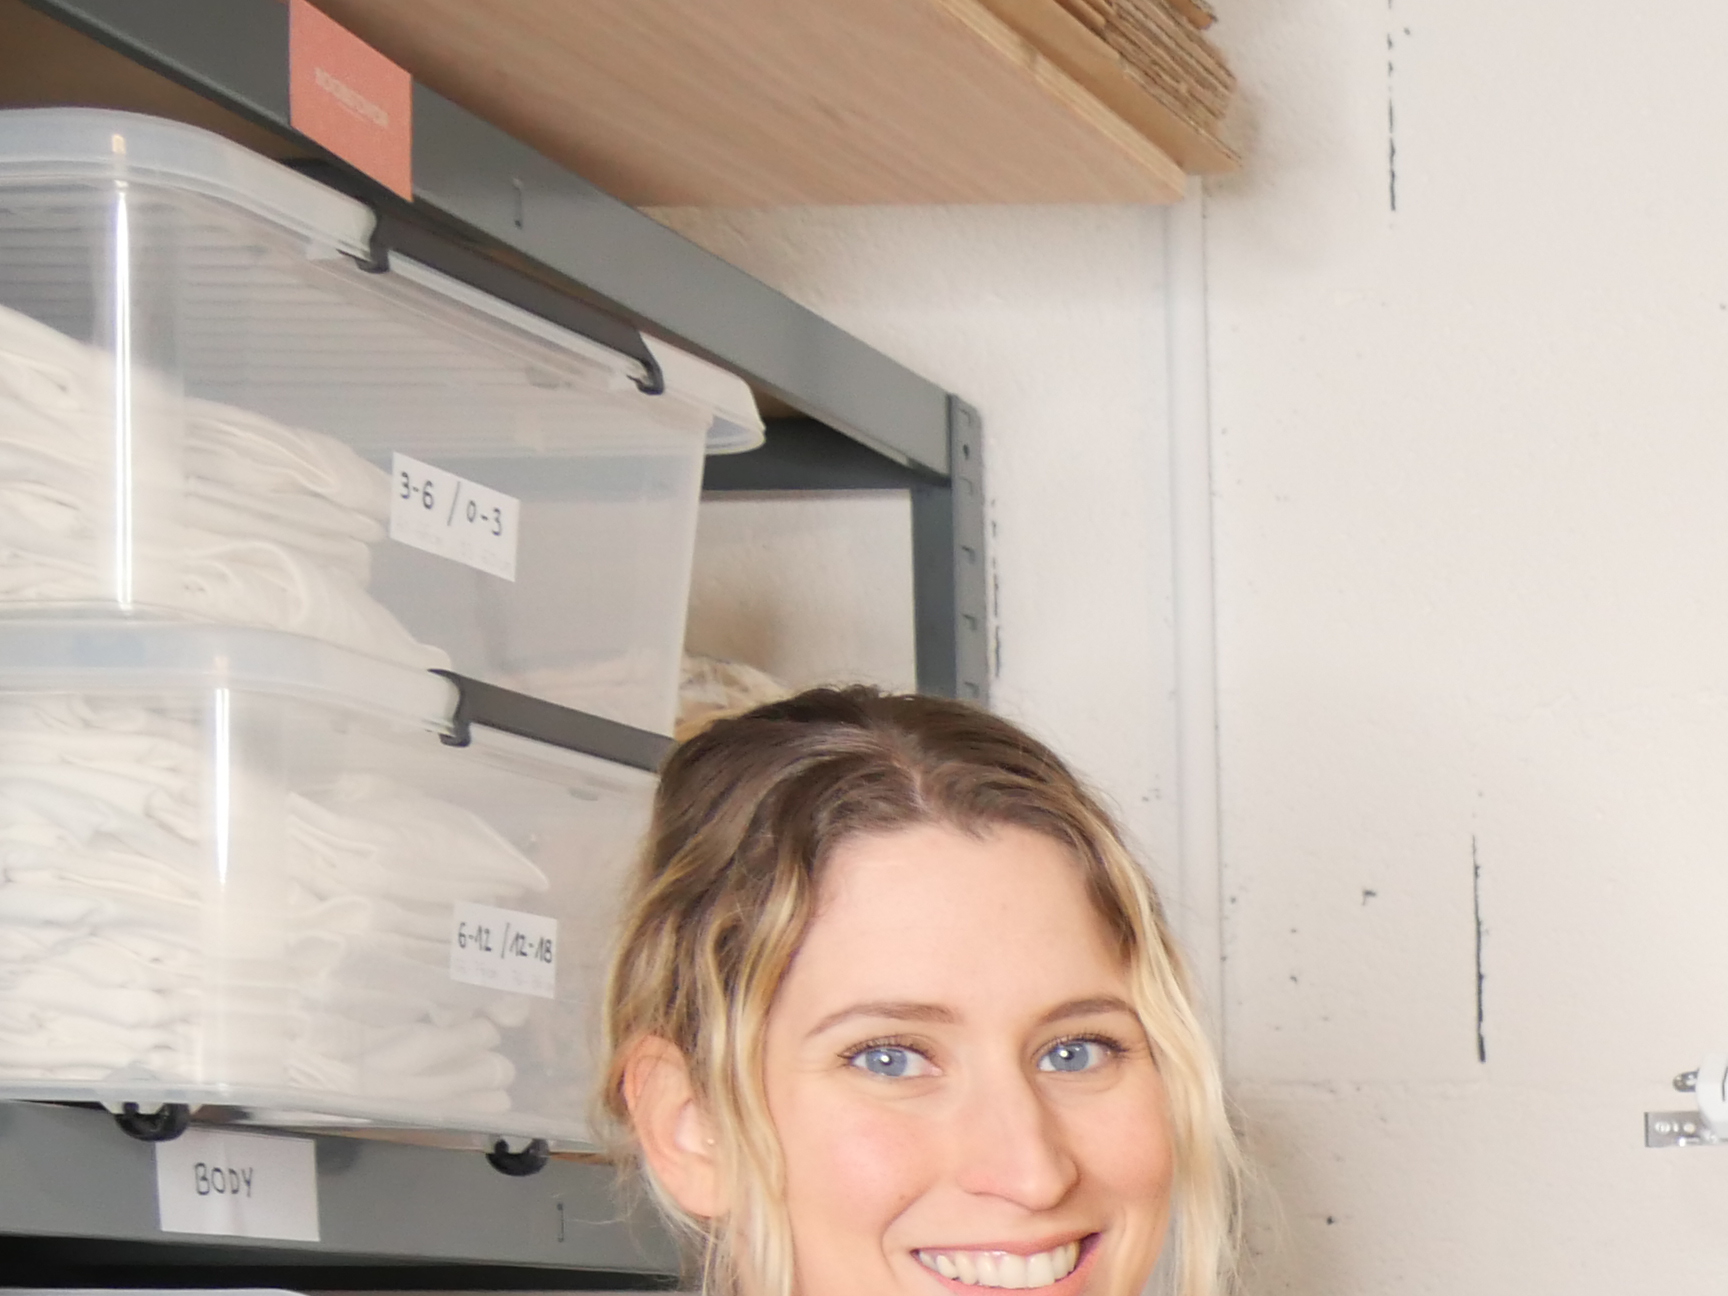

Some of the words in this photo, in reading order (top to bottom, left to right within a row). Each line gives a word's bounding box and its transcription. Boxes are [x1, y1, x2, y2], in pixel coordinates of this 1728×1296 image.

[400, 470, 435, 510] 3-6
[466, 500, 503, 536] 0-3
[194, 1162, 253, 1198] BODY
